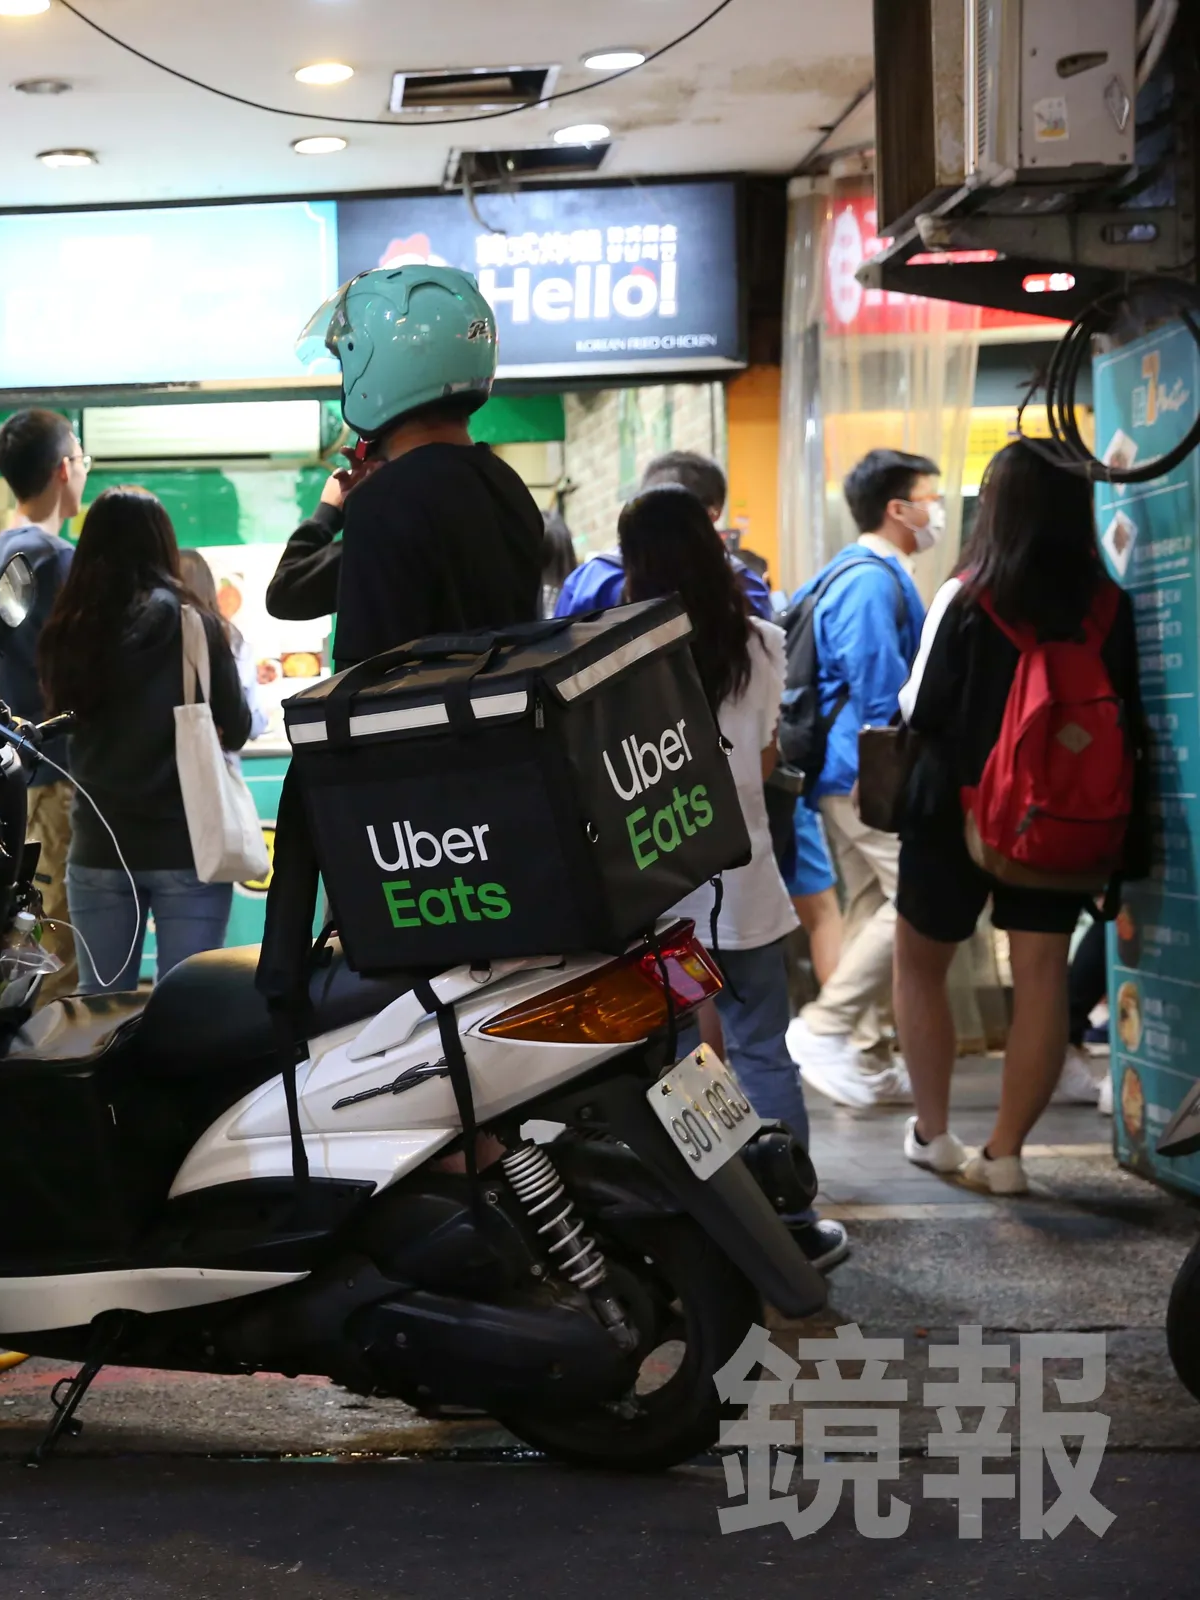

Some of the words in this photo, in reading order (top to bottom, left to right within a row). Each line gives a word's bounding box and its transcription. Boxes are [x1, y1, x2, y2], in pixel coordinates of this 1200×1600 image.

[478, 261, 678, 323] Hello!
[602, 718, 694, 802] Uber
[366, 820, 490, 872] Uber
[625, 783, 714, 871] Eats
[381, 876, 512, 929] Eats
